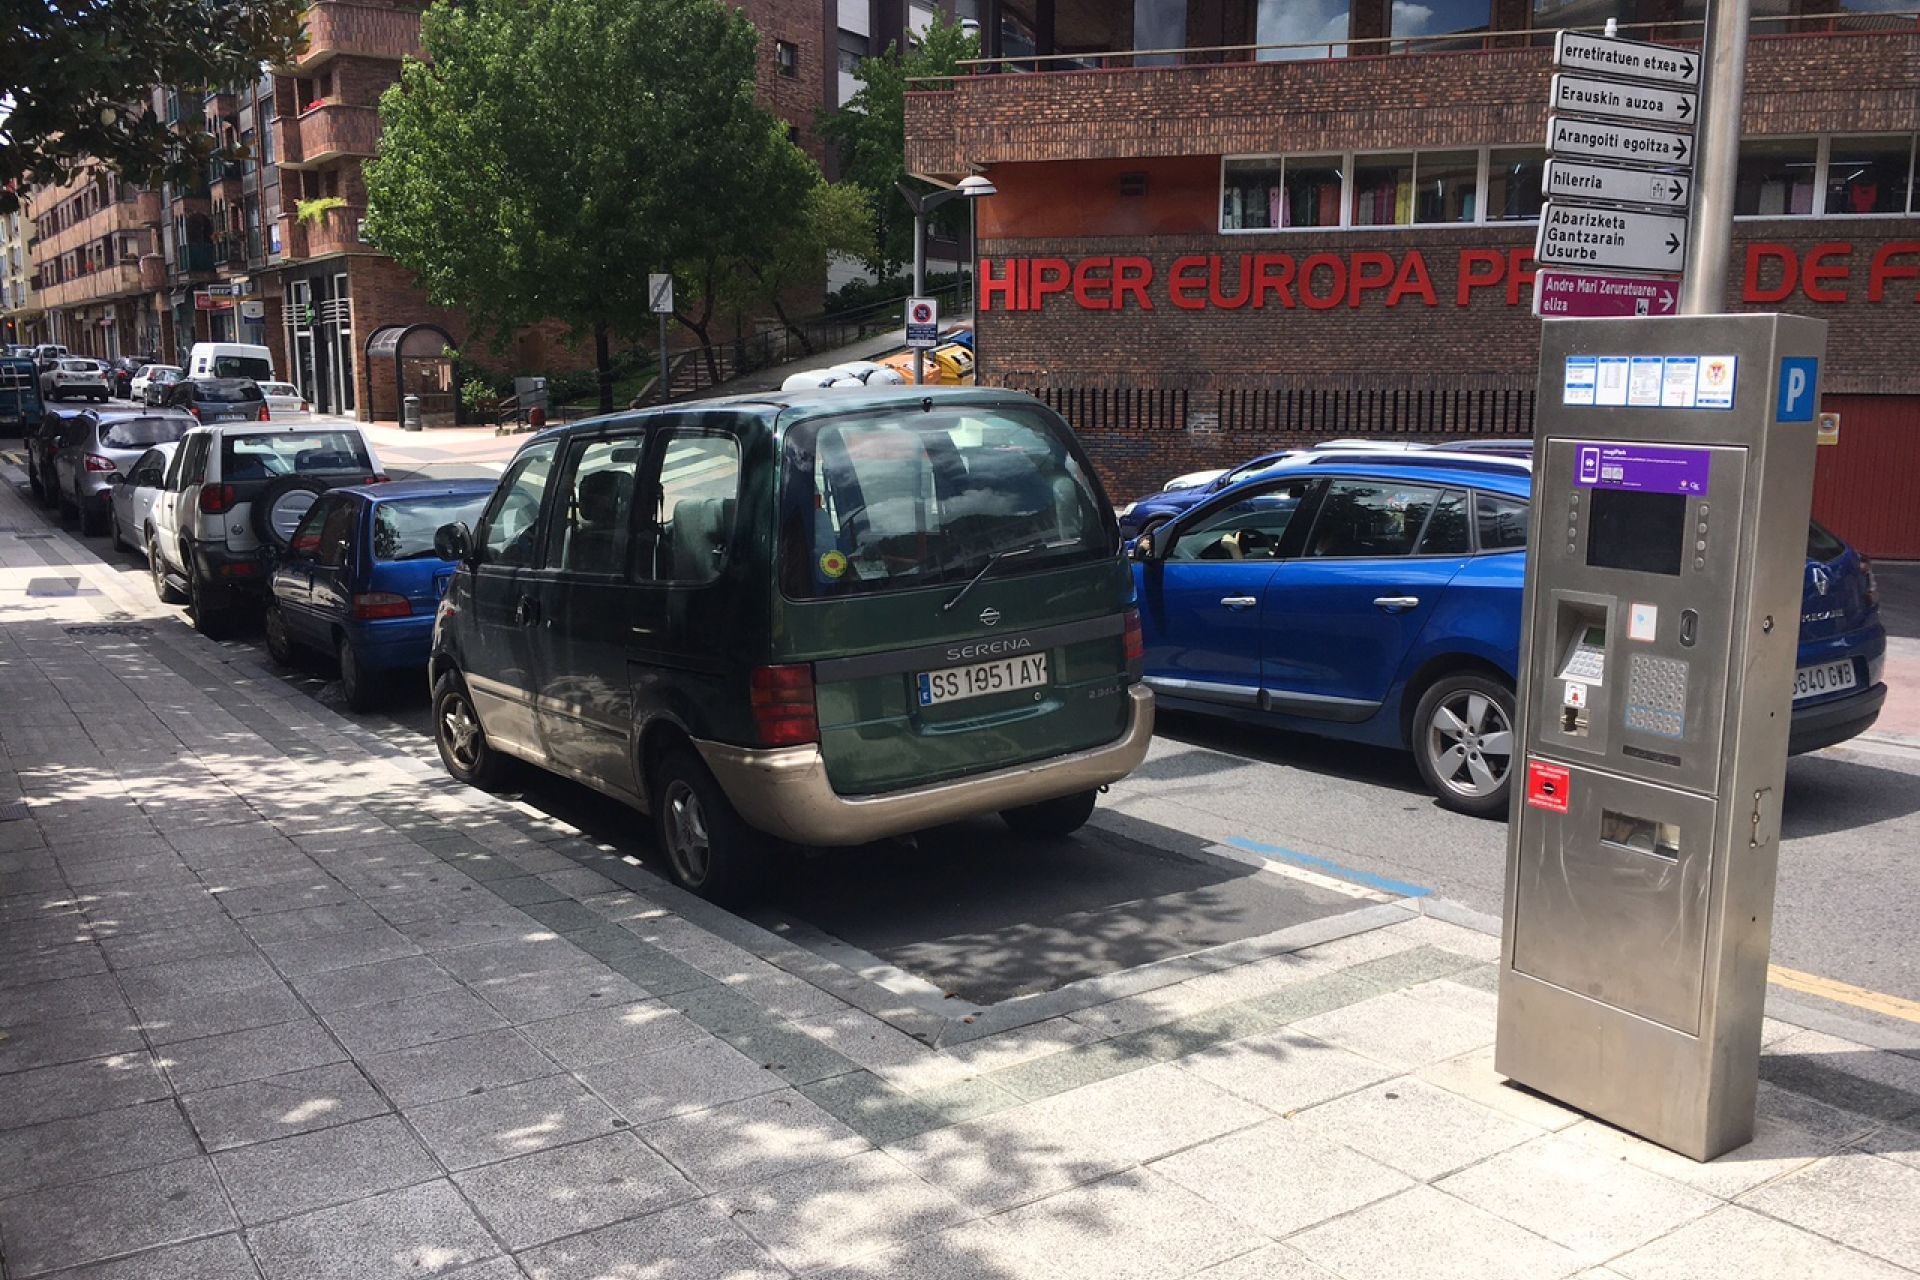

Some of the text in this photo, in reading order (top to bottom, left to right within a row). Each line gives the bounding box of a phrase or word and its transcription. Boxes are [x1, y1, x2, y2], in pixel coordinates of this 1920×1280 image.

[1565, 45, 1677, 73] erretiratuen etxea
[1561, 86, 1664, 112] Erauskin auzoa
[1557, 128, 1669, 153] Arangoiti egoitza
[1553, 171, 1603, 189] hilerria
[1550, 210, 1626, 230] Abarizketa
[1547, 227, 1625, 246] Gantzarain
[1546, 243, 1597, 260] Usurbe
[980, 241, 1920, 311] HIPER EUROPA PR DE F
[1545, 277, 1574, 292] Andre
[1577, 279, 1598, 294] Mari
[1543, 297, 1569, 311] eliza
[1786, 367, 1806, 413] P
[946, 638, 1032, 661] SERENA
[932, 671, 959, 699] SS
[965, 661, 1014, 694] 1951
[1020, 656, 1043, 685] AY
